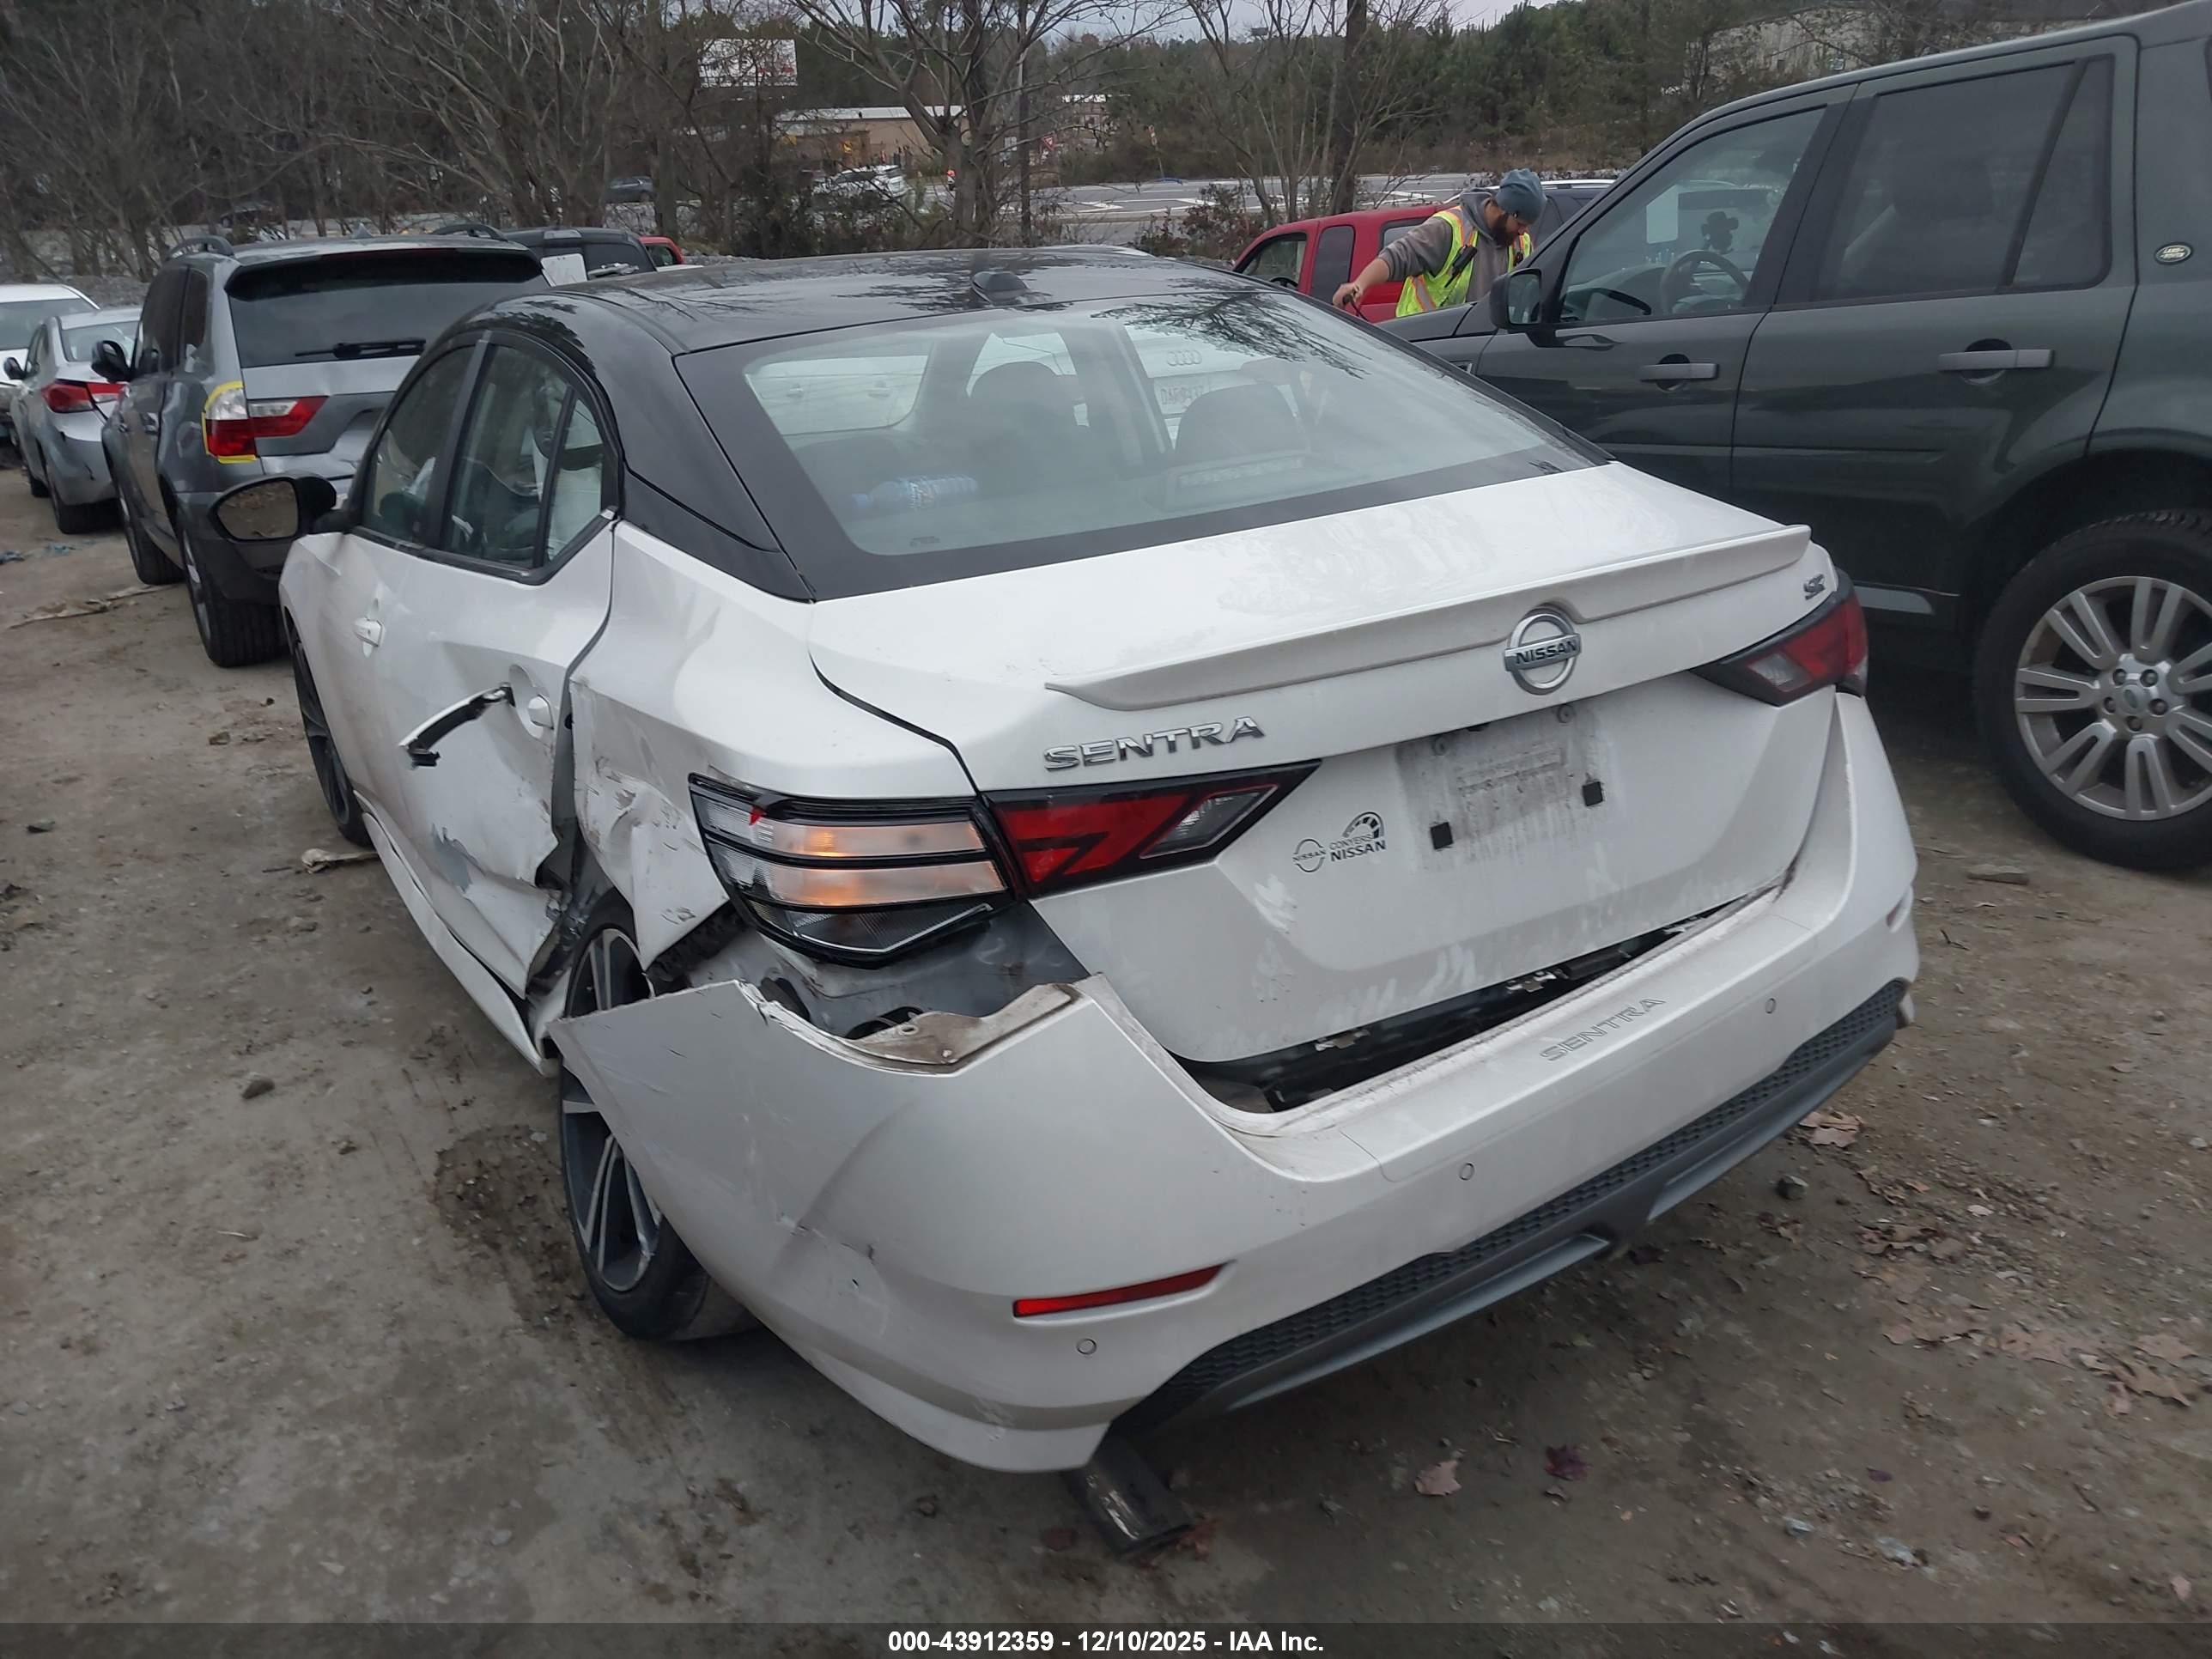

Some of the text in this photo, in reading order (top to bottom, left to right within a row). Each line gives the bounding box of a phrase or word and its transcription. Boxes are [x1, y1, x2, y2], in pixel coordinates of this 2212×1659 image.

[1516, 640, 1577, 665] NISSAN
[1043, 715, 1265, 772] SENTRA
[1292, 850, 1326, 861] NISSAN
[1330, 840, 1386, 862] NISSAN
[1540, 998, 1667, 1061] SENTRA
